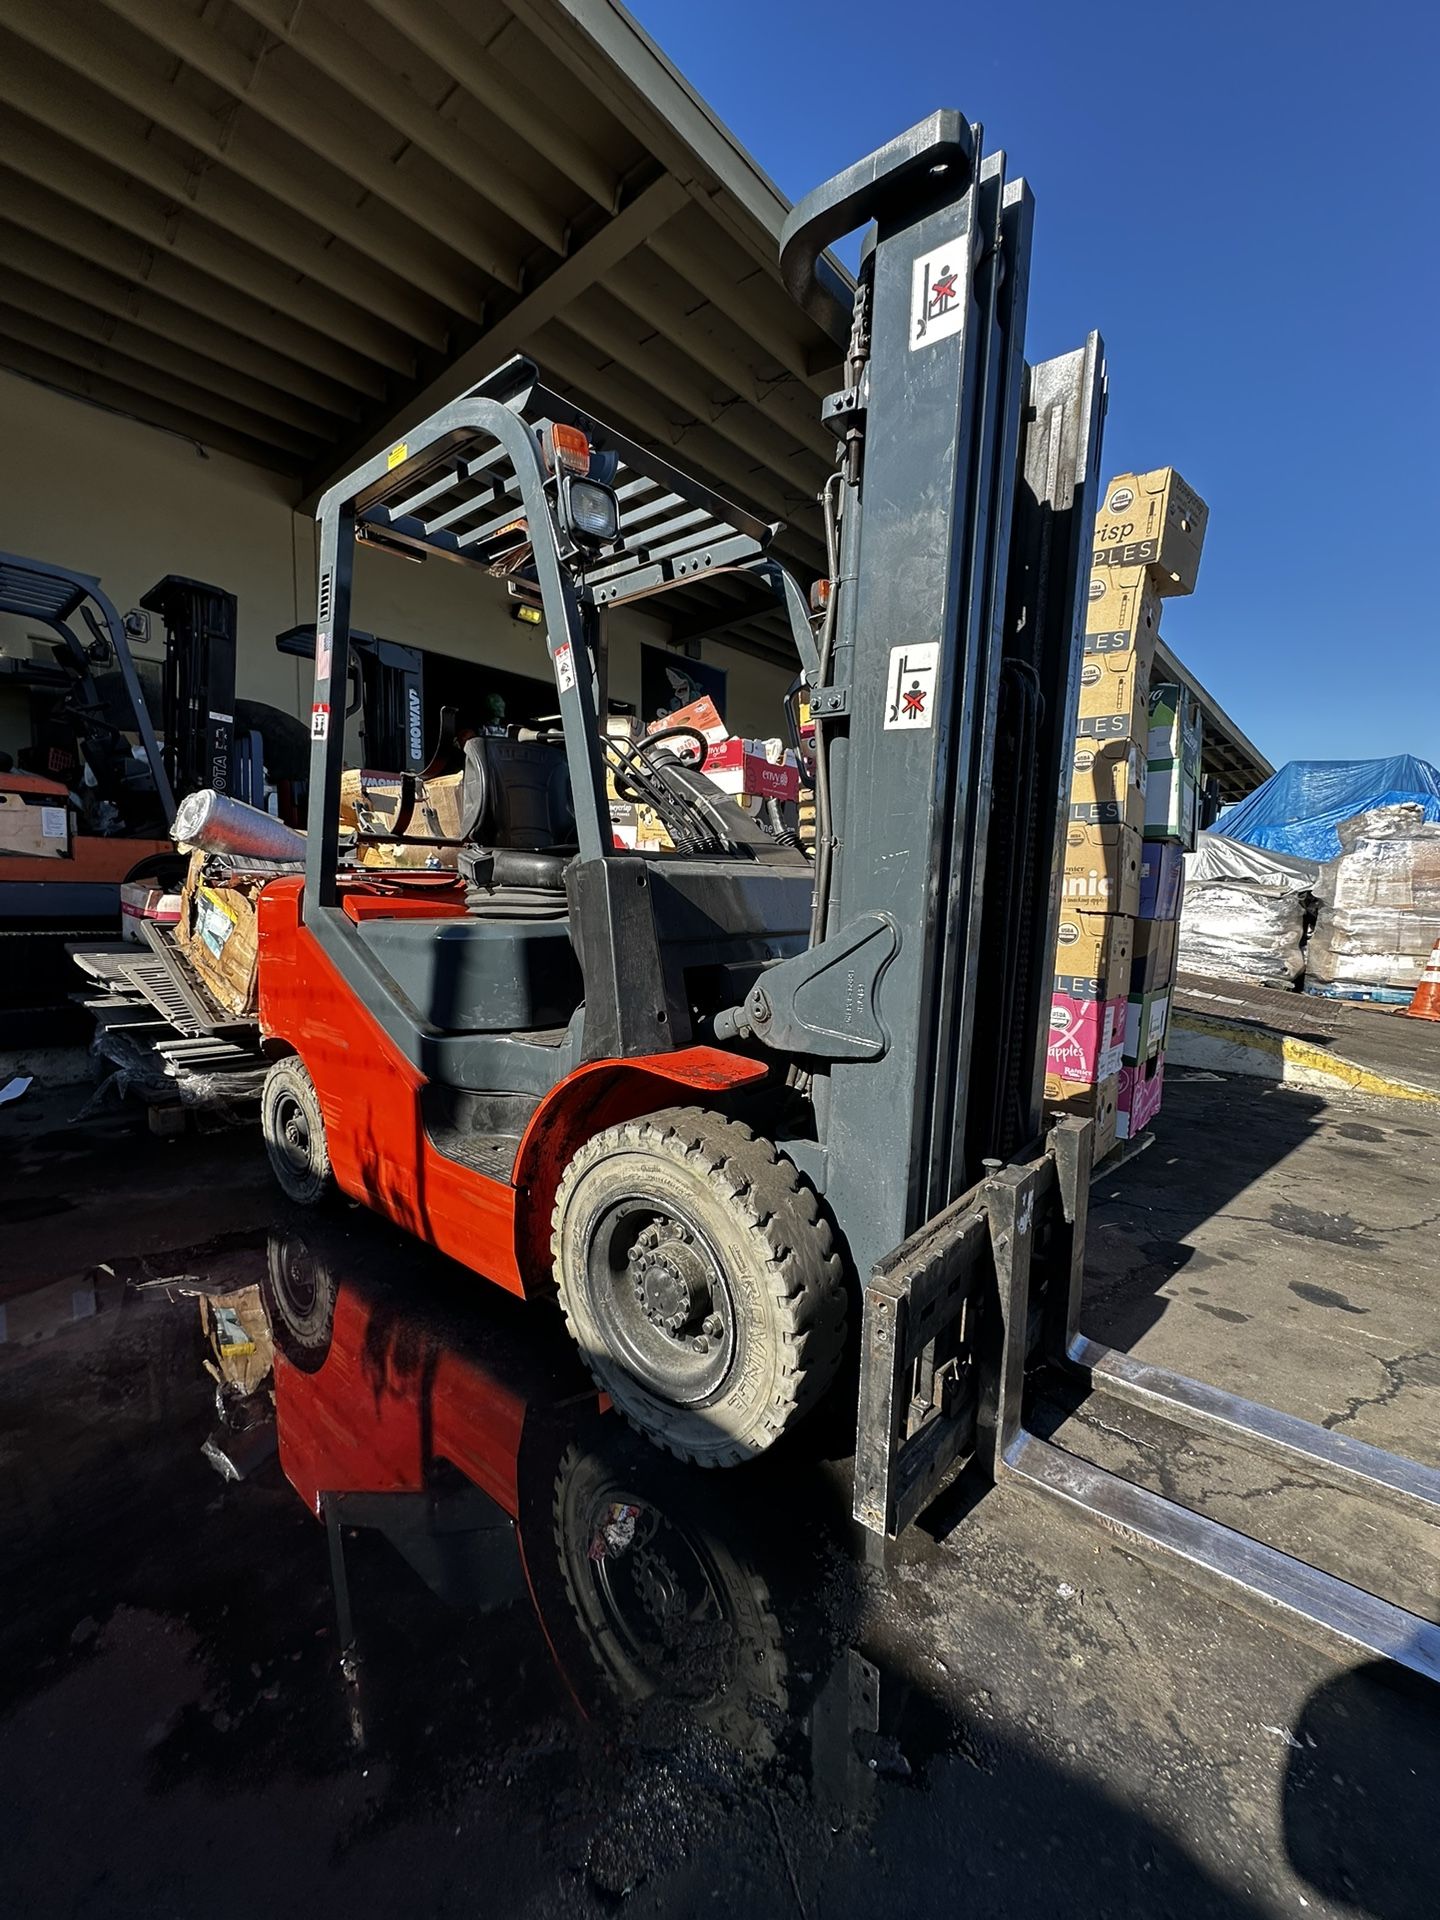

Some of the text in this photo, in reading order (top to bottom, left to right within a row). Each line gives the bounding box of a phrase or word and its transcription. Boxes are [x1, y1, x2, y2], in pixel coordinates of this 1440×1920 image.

[1080, 716, 1123, 733] LES
[762, 770, 780, 787] envy
[1075, 803, 1118, 819] LES
[1058, 976, 1100, 994] LES
[1048, 1044, 1084, 1063] apples
